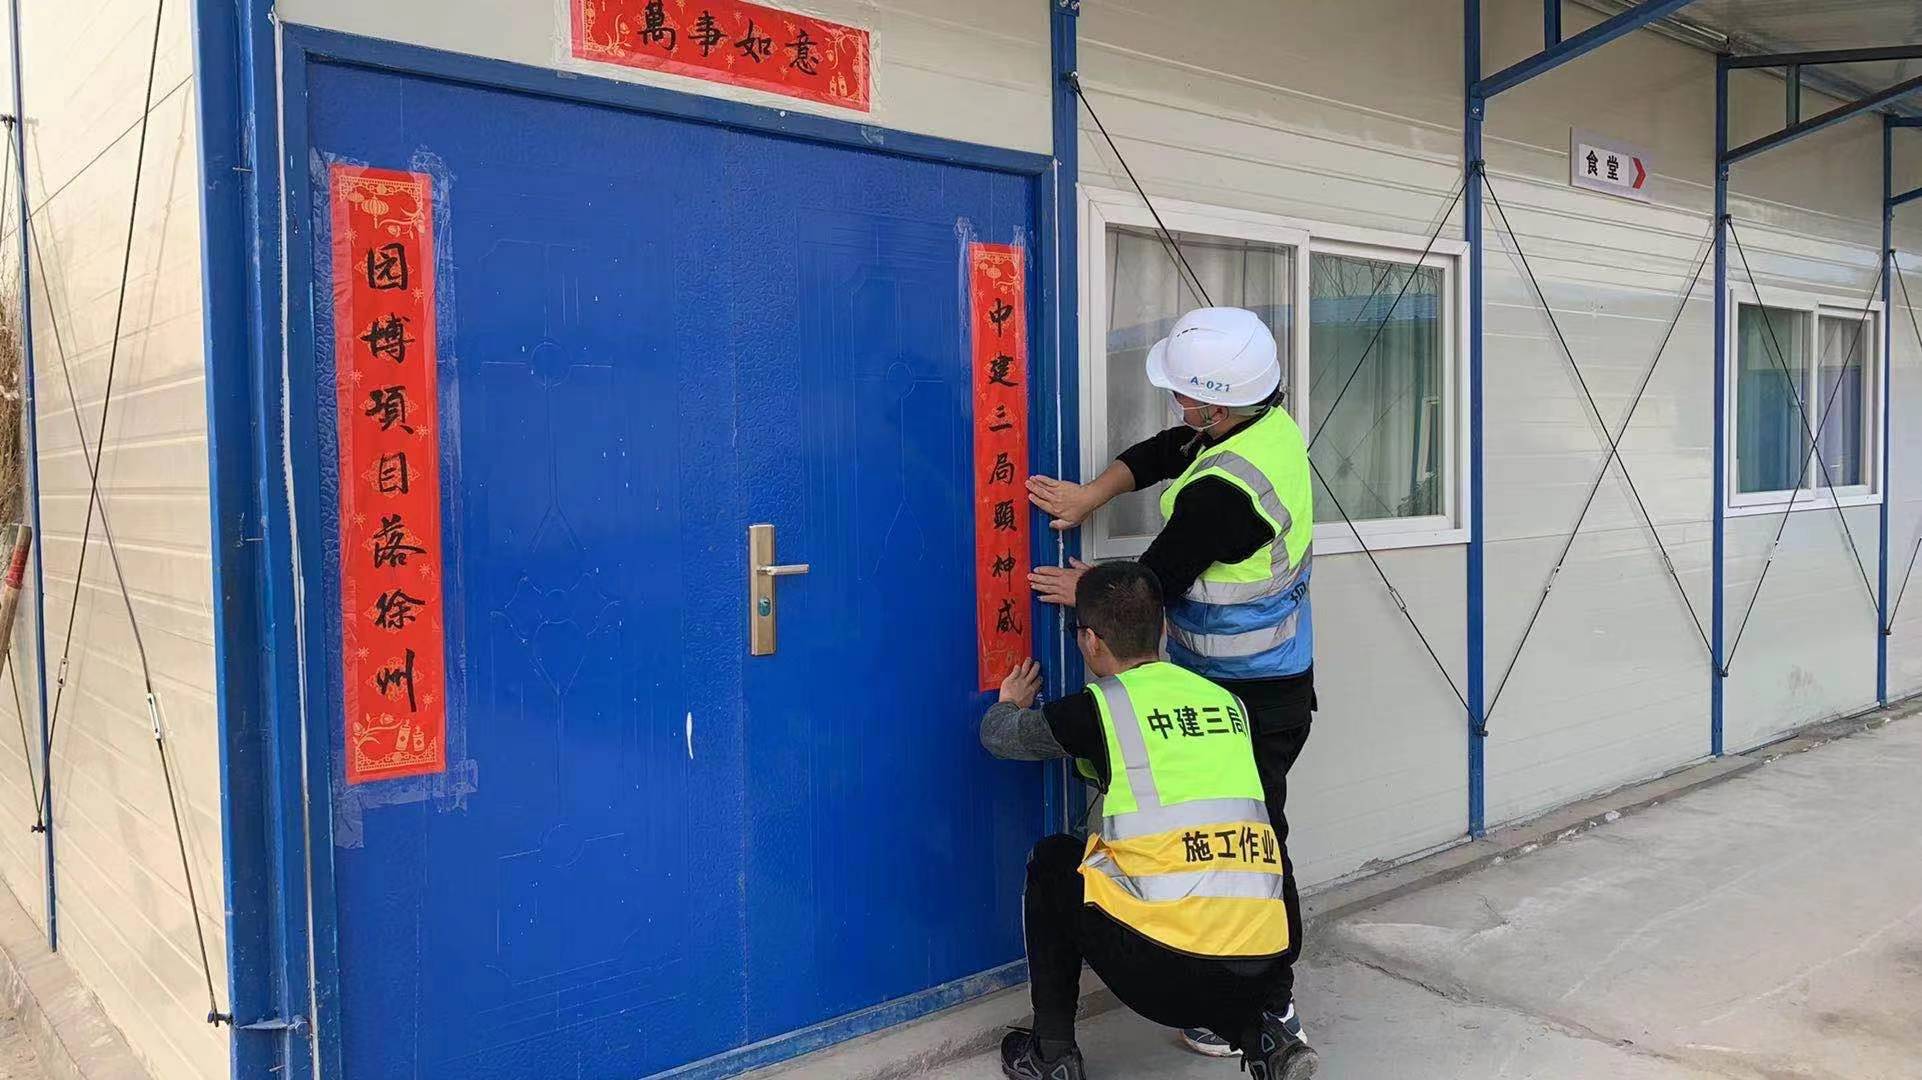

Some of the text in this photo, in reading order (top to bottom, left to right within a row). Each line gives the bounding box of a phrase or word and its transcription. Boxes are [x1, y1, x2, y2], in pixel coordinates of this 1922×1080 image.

[637, 0, 818, 75] 萬事如意
[1586, 150, 1619, 181] 食堂
[1190, 376, 1232, 393] A-021
[1147, 705, 1248, 740] 中建三局
[1182, 826, 1277, 864] 施工作业
